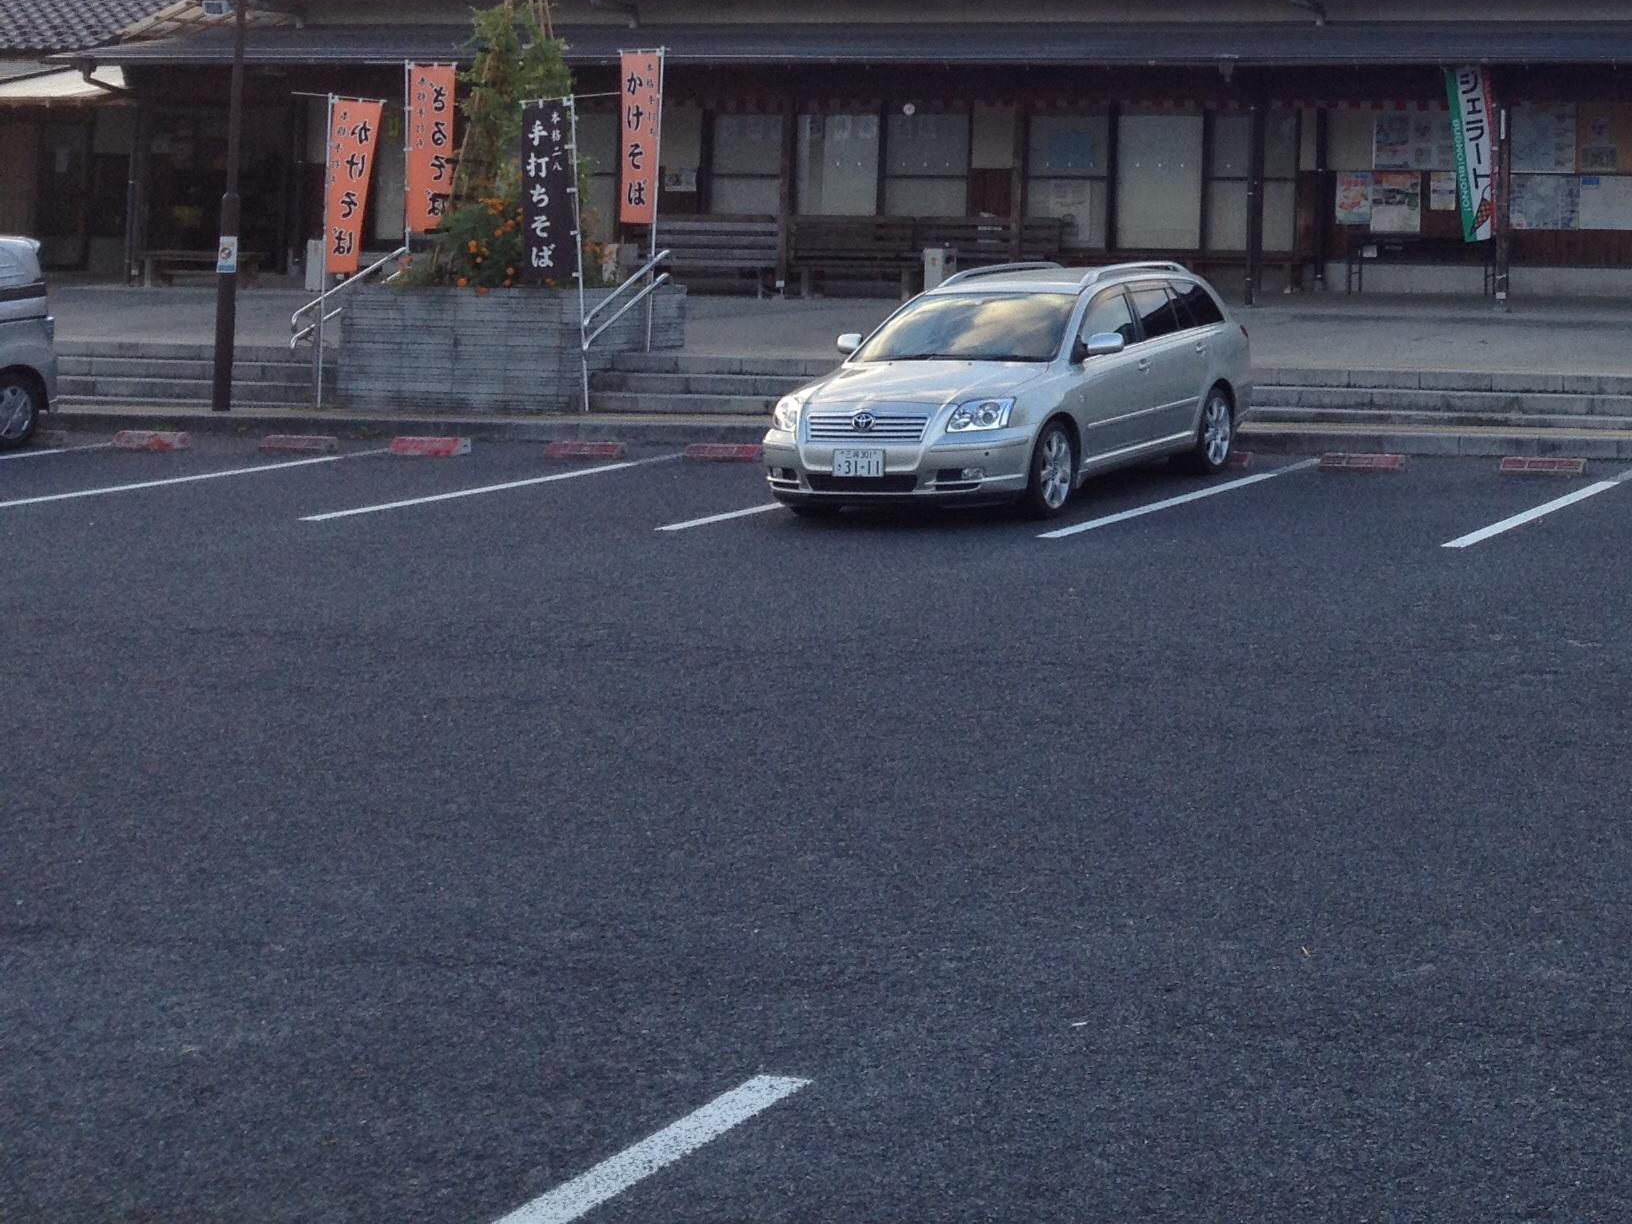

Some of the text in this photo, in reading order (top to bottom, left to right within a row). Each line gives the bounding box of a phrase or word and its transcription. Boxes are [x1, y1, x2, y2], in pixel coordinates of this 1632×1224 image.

[627, 72, 648, 206] かけそば
[1459, 69, 1491, 189] ジェラート
[526, 120, 556, 267] 手打ちそば
[844, 460, 880, 474] 31-11
